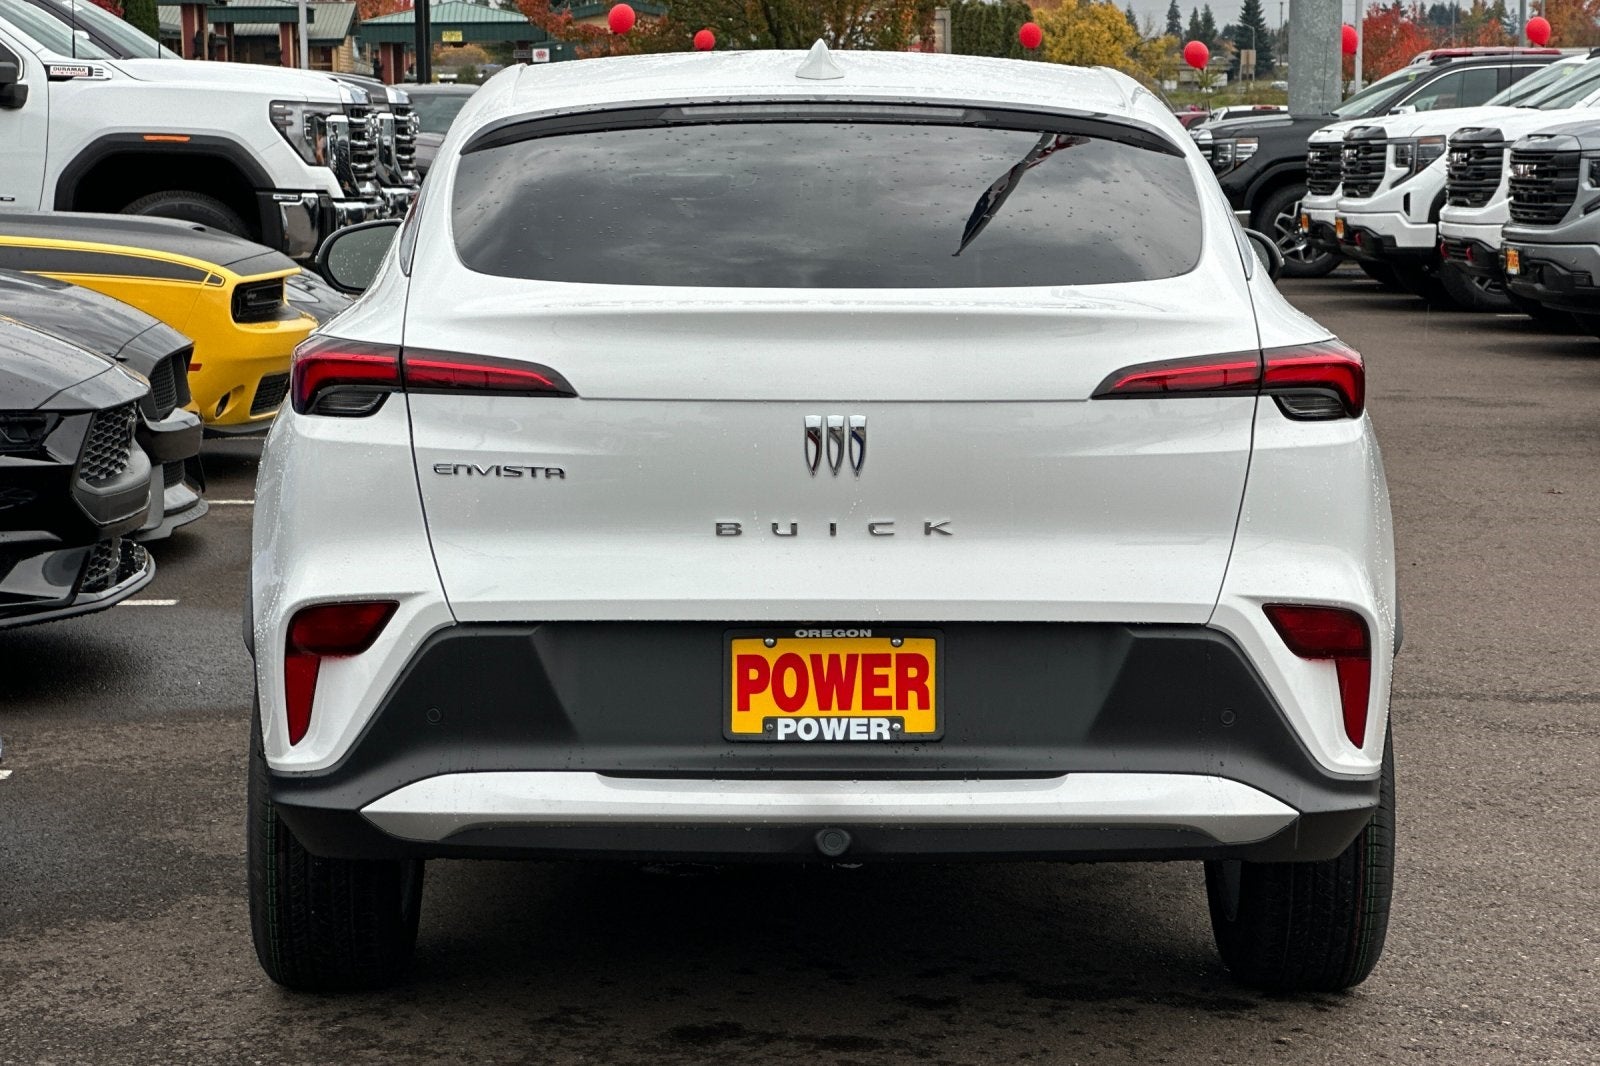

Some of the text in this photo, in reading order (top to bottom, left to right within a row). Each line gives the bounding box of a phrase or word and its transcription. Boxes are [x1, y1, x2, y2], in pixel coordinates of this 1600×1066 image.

[433, 463, 565, 480] ENVISTA
[715, 521, 952, 537] BUICK
[794, 629, 872, 638] OREGON
[736, 652, 931, 713] POWER
[777, 717, 891, 741] POWER
